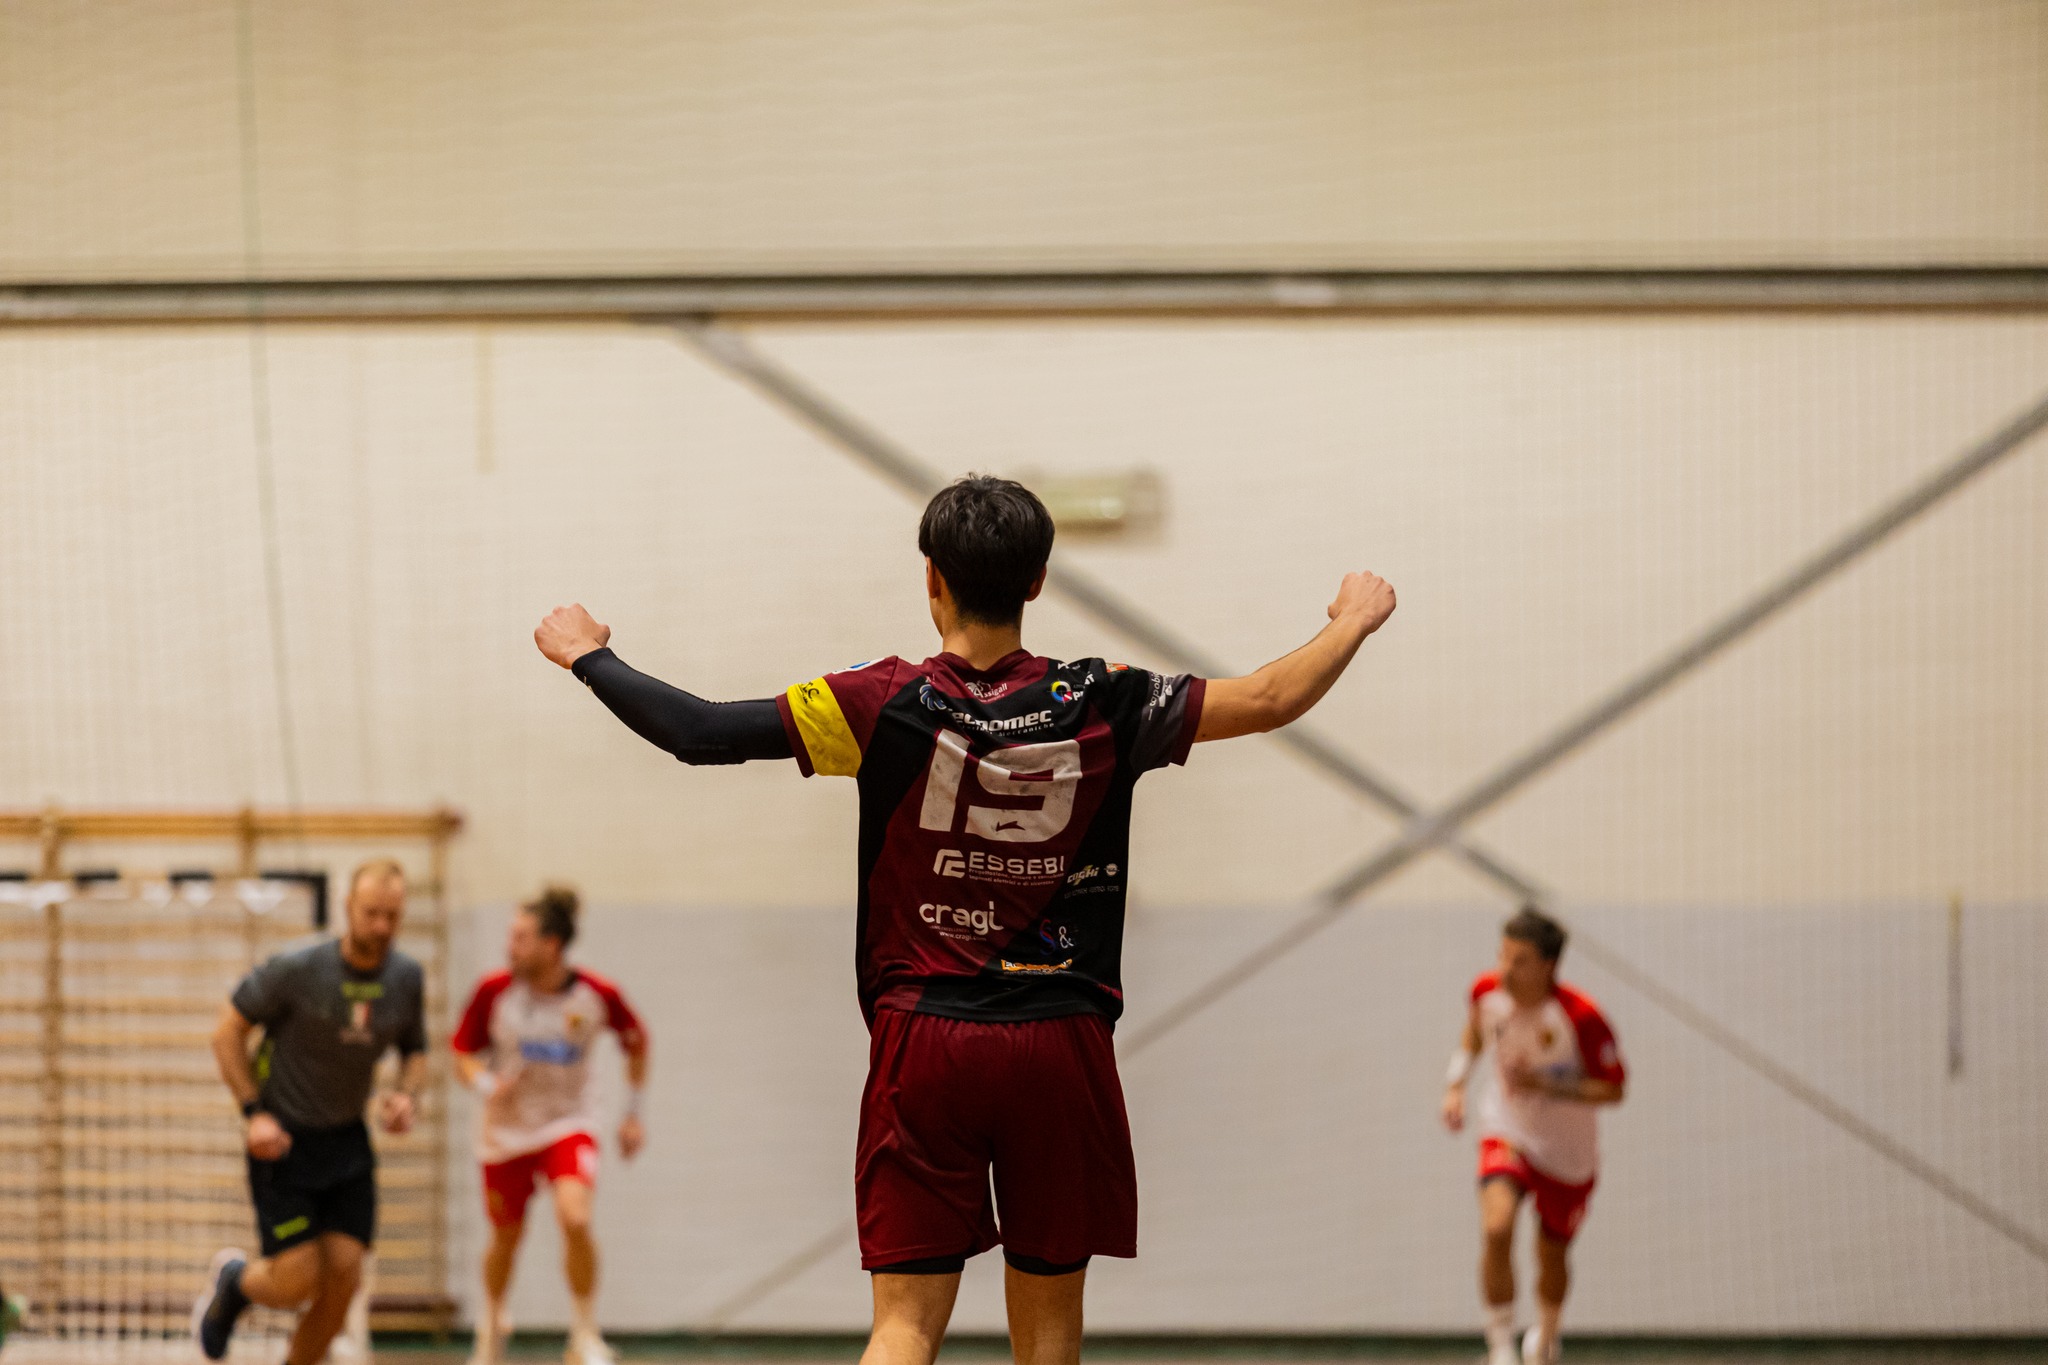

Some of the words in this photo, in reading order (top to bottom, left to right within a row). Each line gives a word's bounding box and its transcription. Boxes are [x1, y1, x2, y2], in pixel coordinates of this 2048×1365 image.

[919, 729, 1083, 842] 19
[968, 851, 1065, 875] ESSEBI
[918, 900, 1005, 936] cragi
